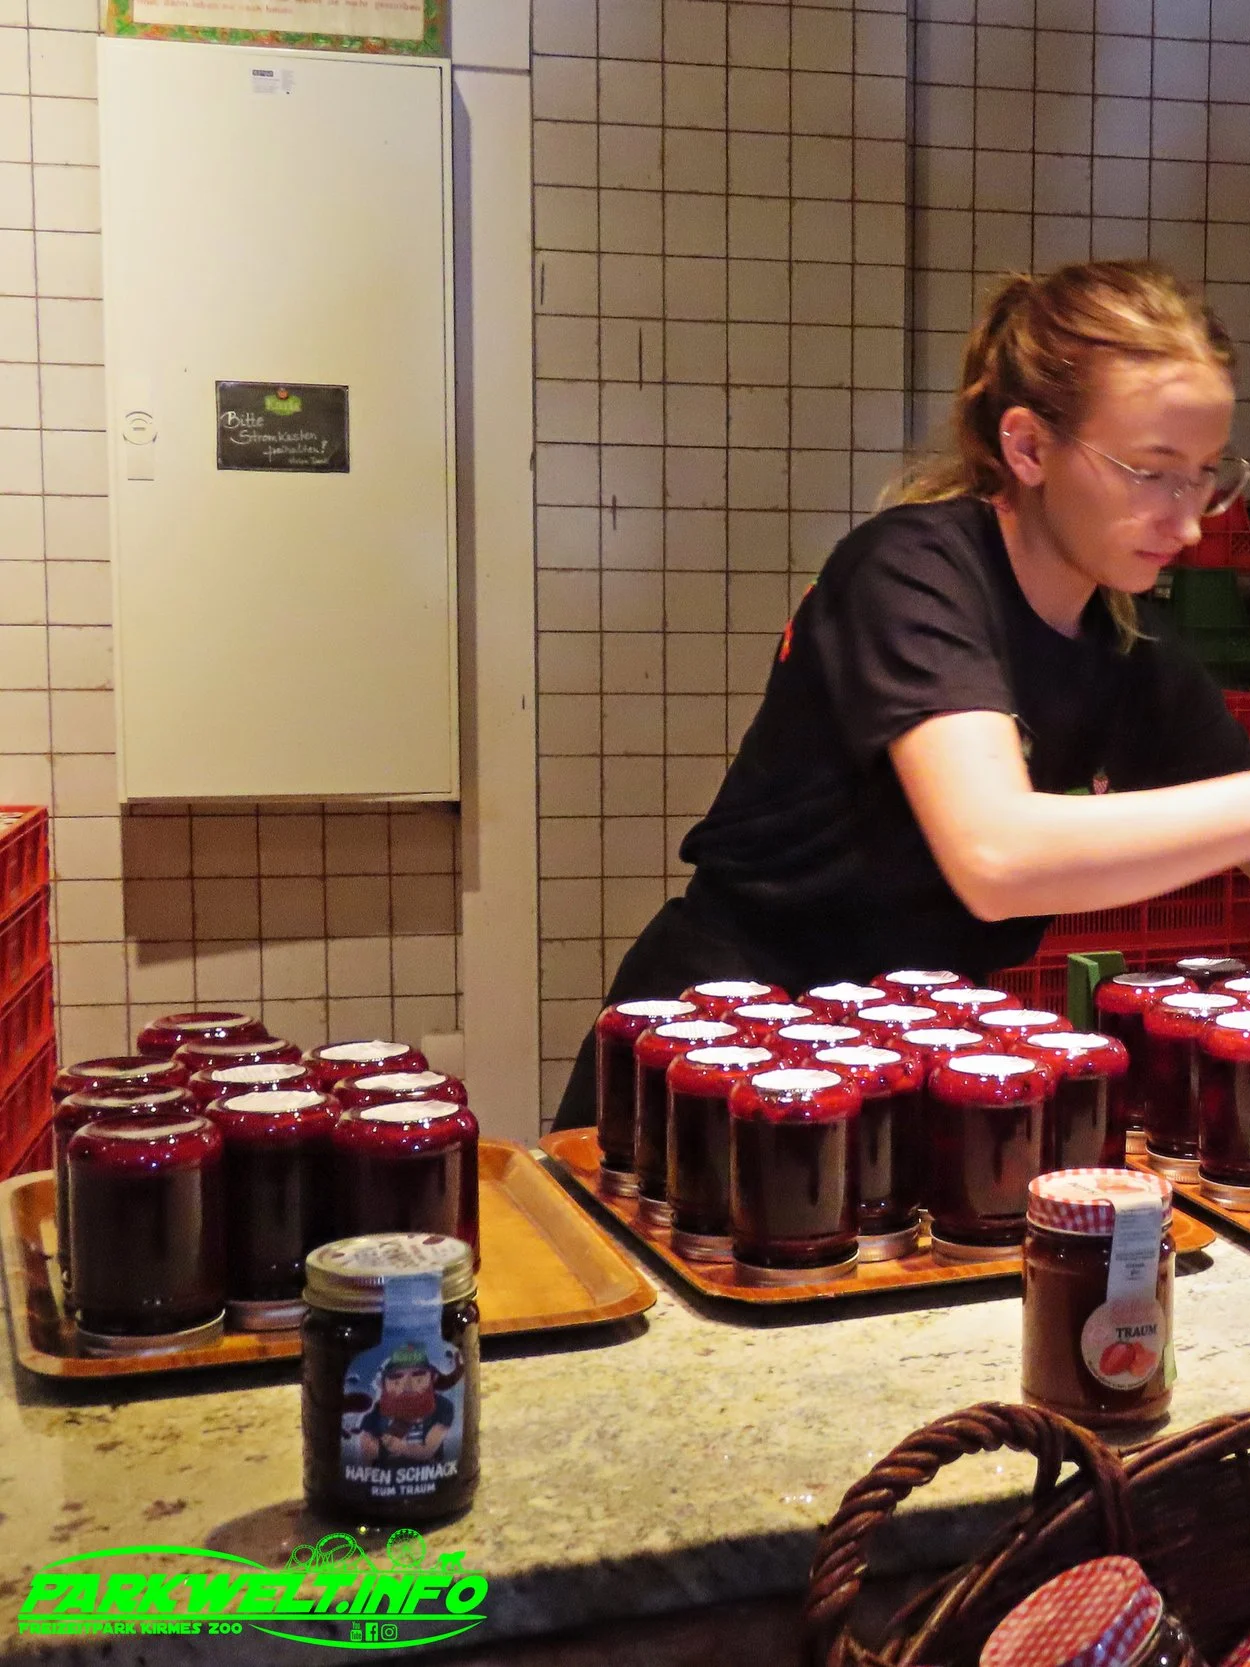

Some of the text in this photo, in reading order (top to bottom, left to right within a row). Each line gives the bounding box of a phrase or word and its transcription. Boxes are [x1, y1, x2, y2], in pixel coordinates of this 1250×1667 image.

[220, 410, 264, 429] Bitte
[1115, 1323, 1158, 1339] TRAUM
[345, 1461, 458, 1484] HAFEN SCHNACK
[371, 1483, 436, 1496] RUM TRAUM
